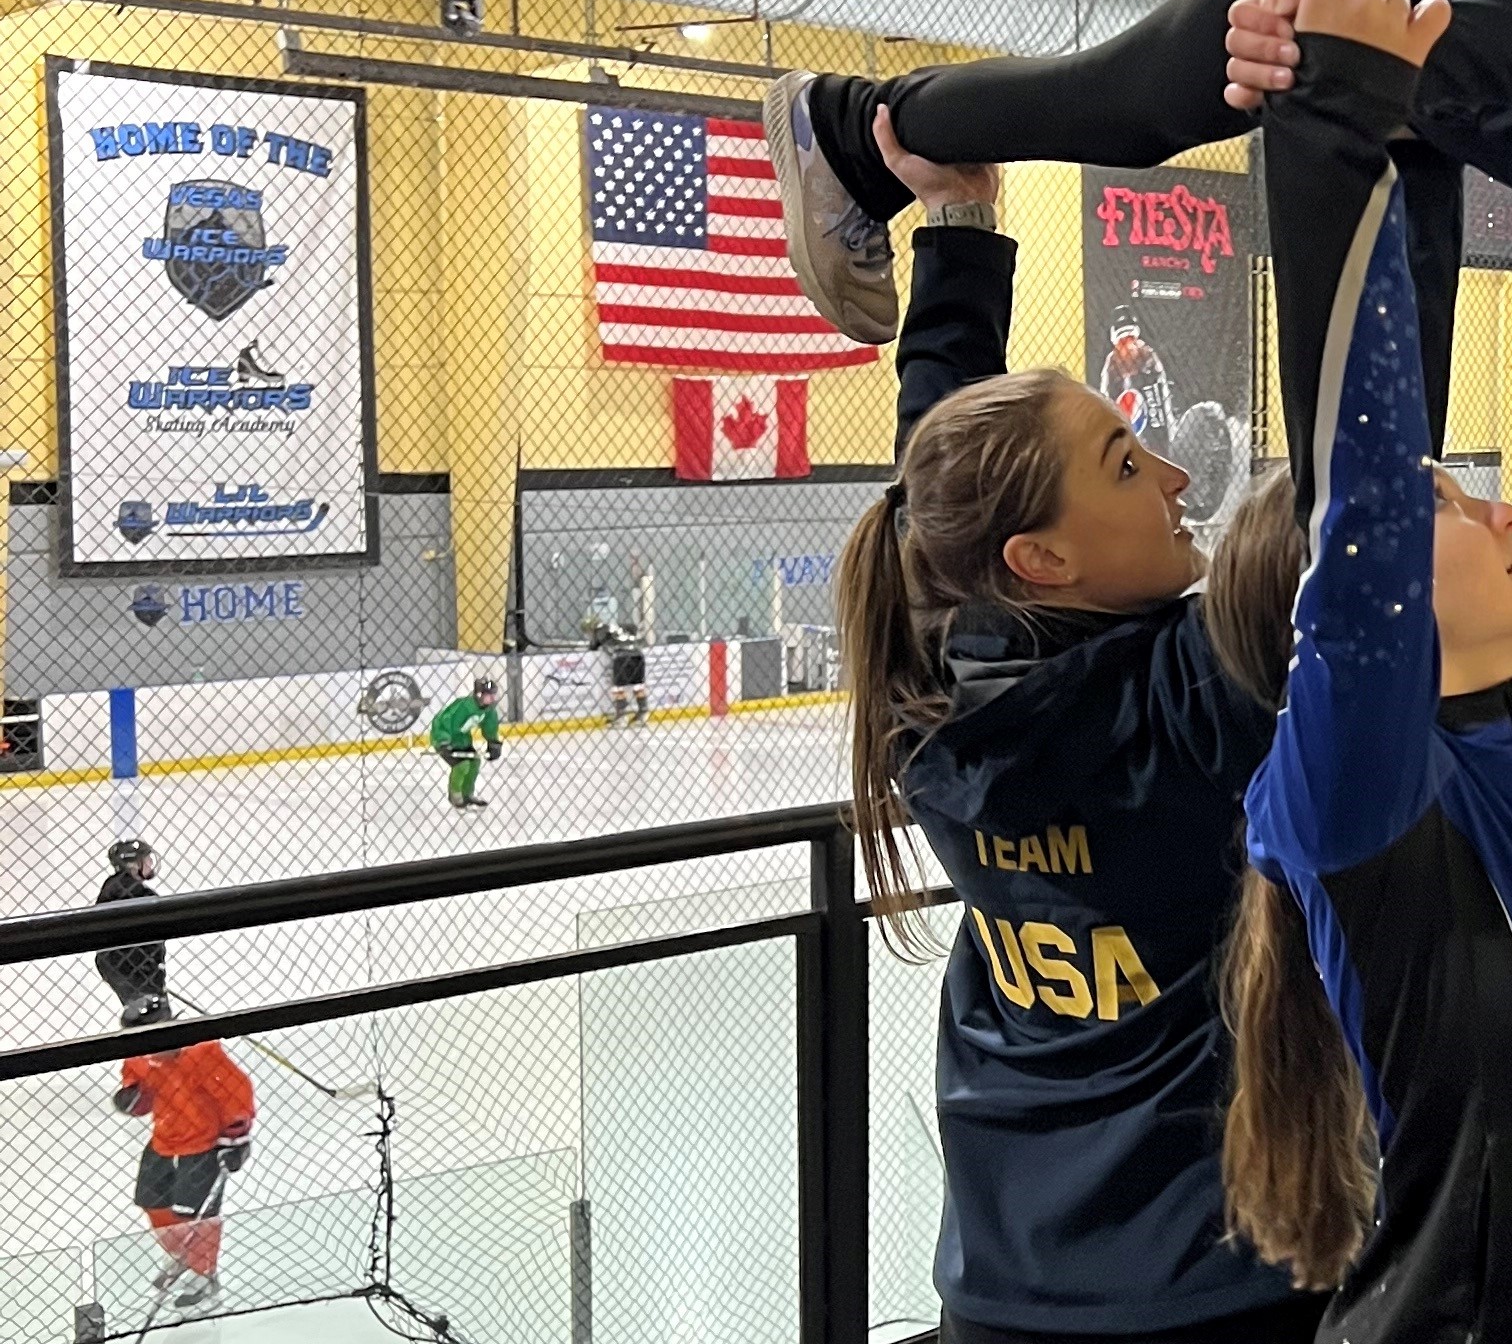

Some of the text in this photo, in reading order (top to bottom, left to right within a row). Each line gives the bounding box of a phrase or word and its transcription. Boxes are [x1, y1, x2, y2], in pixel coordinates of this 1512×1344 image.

[91, 122, 334, 179] HOME OF THE
[170, 185, 264, 211] VEGAS
[189, 228, 241, 246] ICE
[1097, 184, 1235, 274] FIESTA
[142, 237, 290, 265] WARRIORS
[168, 366, 234, 386] ICE
[127, 381, 315, 413] WARRIORS
[145, 414, 296, 438] Skating Academy
[164, 499, 315, 524] WARRIORS
[180, 581, 303, 625] HOME
[975, 825, 1093, 874] TEAM
[972, 906, 1161, 1021] USA
